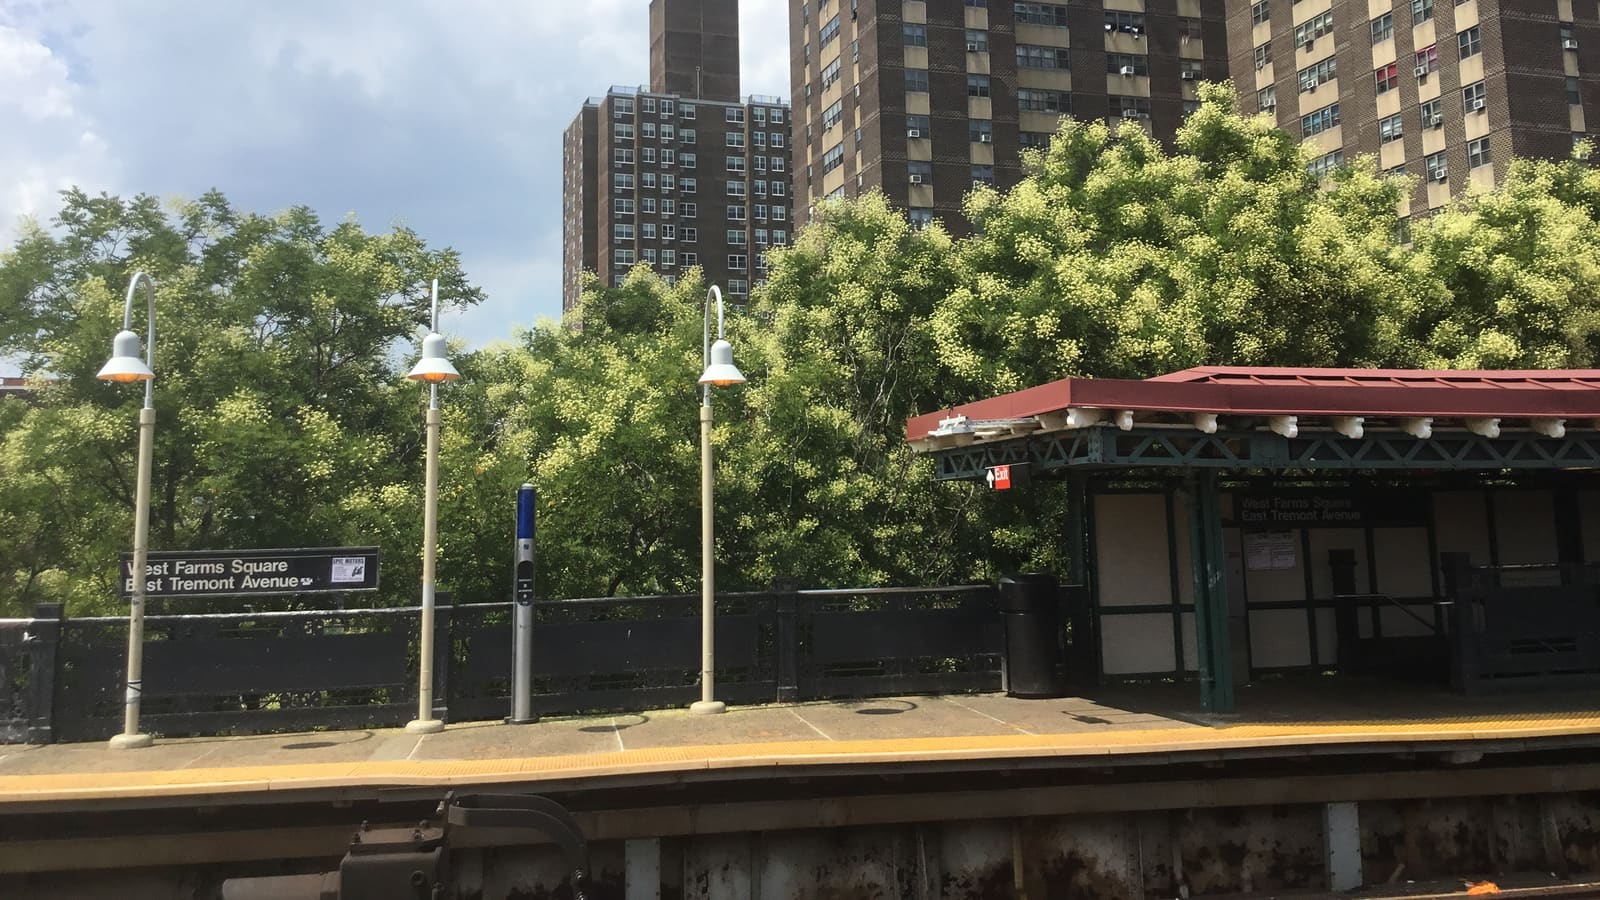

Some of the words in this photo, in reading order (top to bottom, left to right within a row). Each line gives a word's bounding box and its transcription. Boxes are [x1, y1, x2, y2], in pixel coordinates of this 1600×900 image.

[1314, 495, 1352, 511] Sqe
[1271, 509, 1318, 521] Tremont
[175, 561, 225, 575] Farms
[231, 559, 288, 576] Square
[125, 578, 163, 592] Est
[169, 576, 235, 591] Tremont
[241, 575, 299, 589] Avenue
